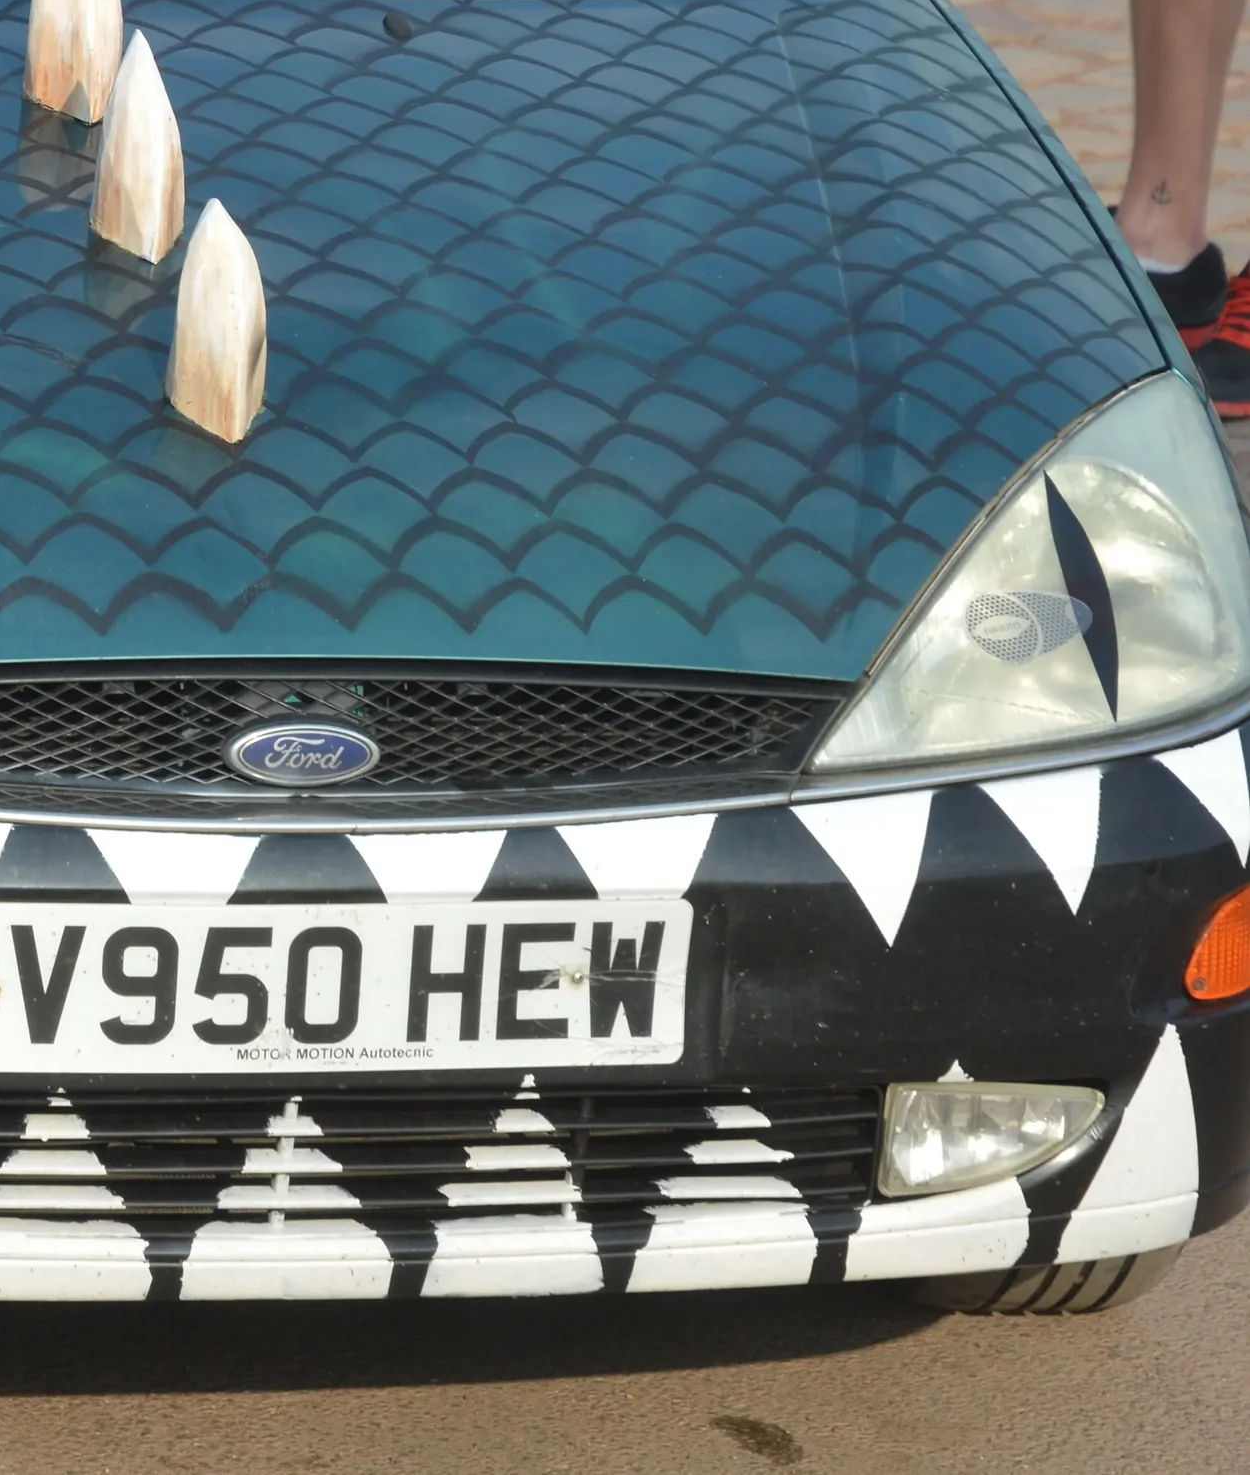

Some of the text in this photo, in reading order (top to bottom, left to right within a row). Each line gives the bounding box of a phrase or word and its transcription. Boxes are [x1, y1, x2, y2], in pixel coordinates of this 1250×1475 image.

[264, 736, 345, 769] Ford
[10, 921, 666, 1045] V950 HEW
[296, 1047, 355, 1060] MOTION
[359, 1046, 434, 1059] Autotecnic
